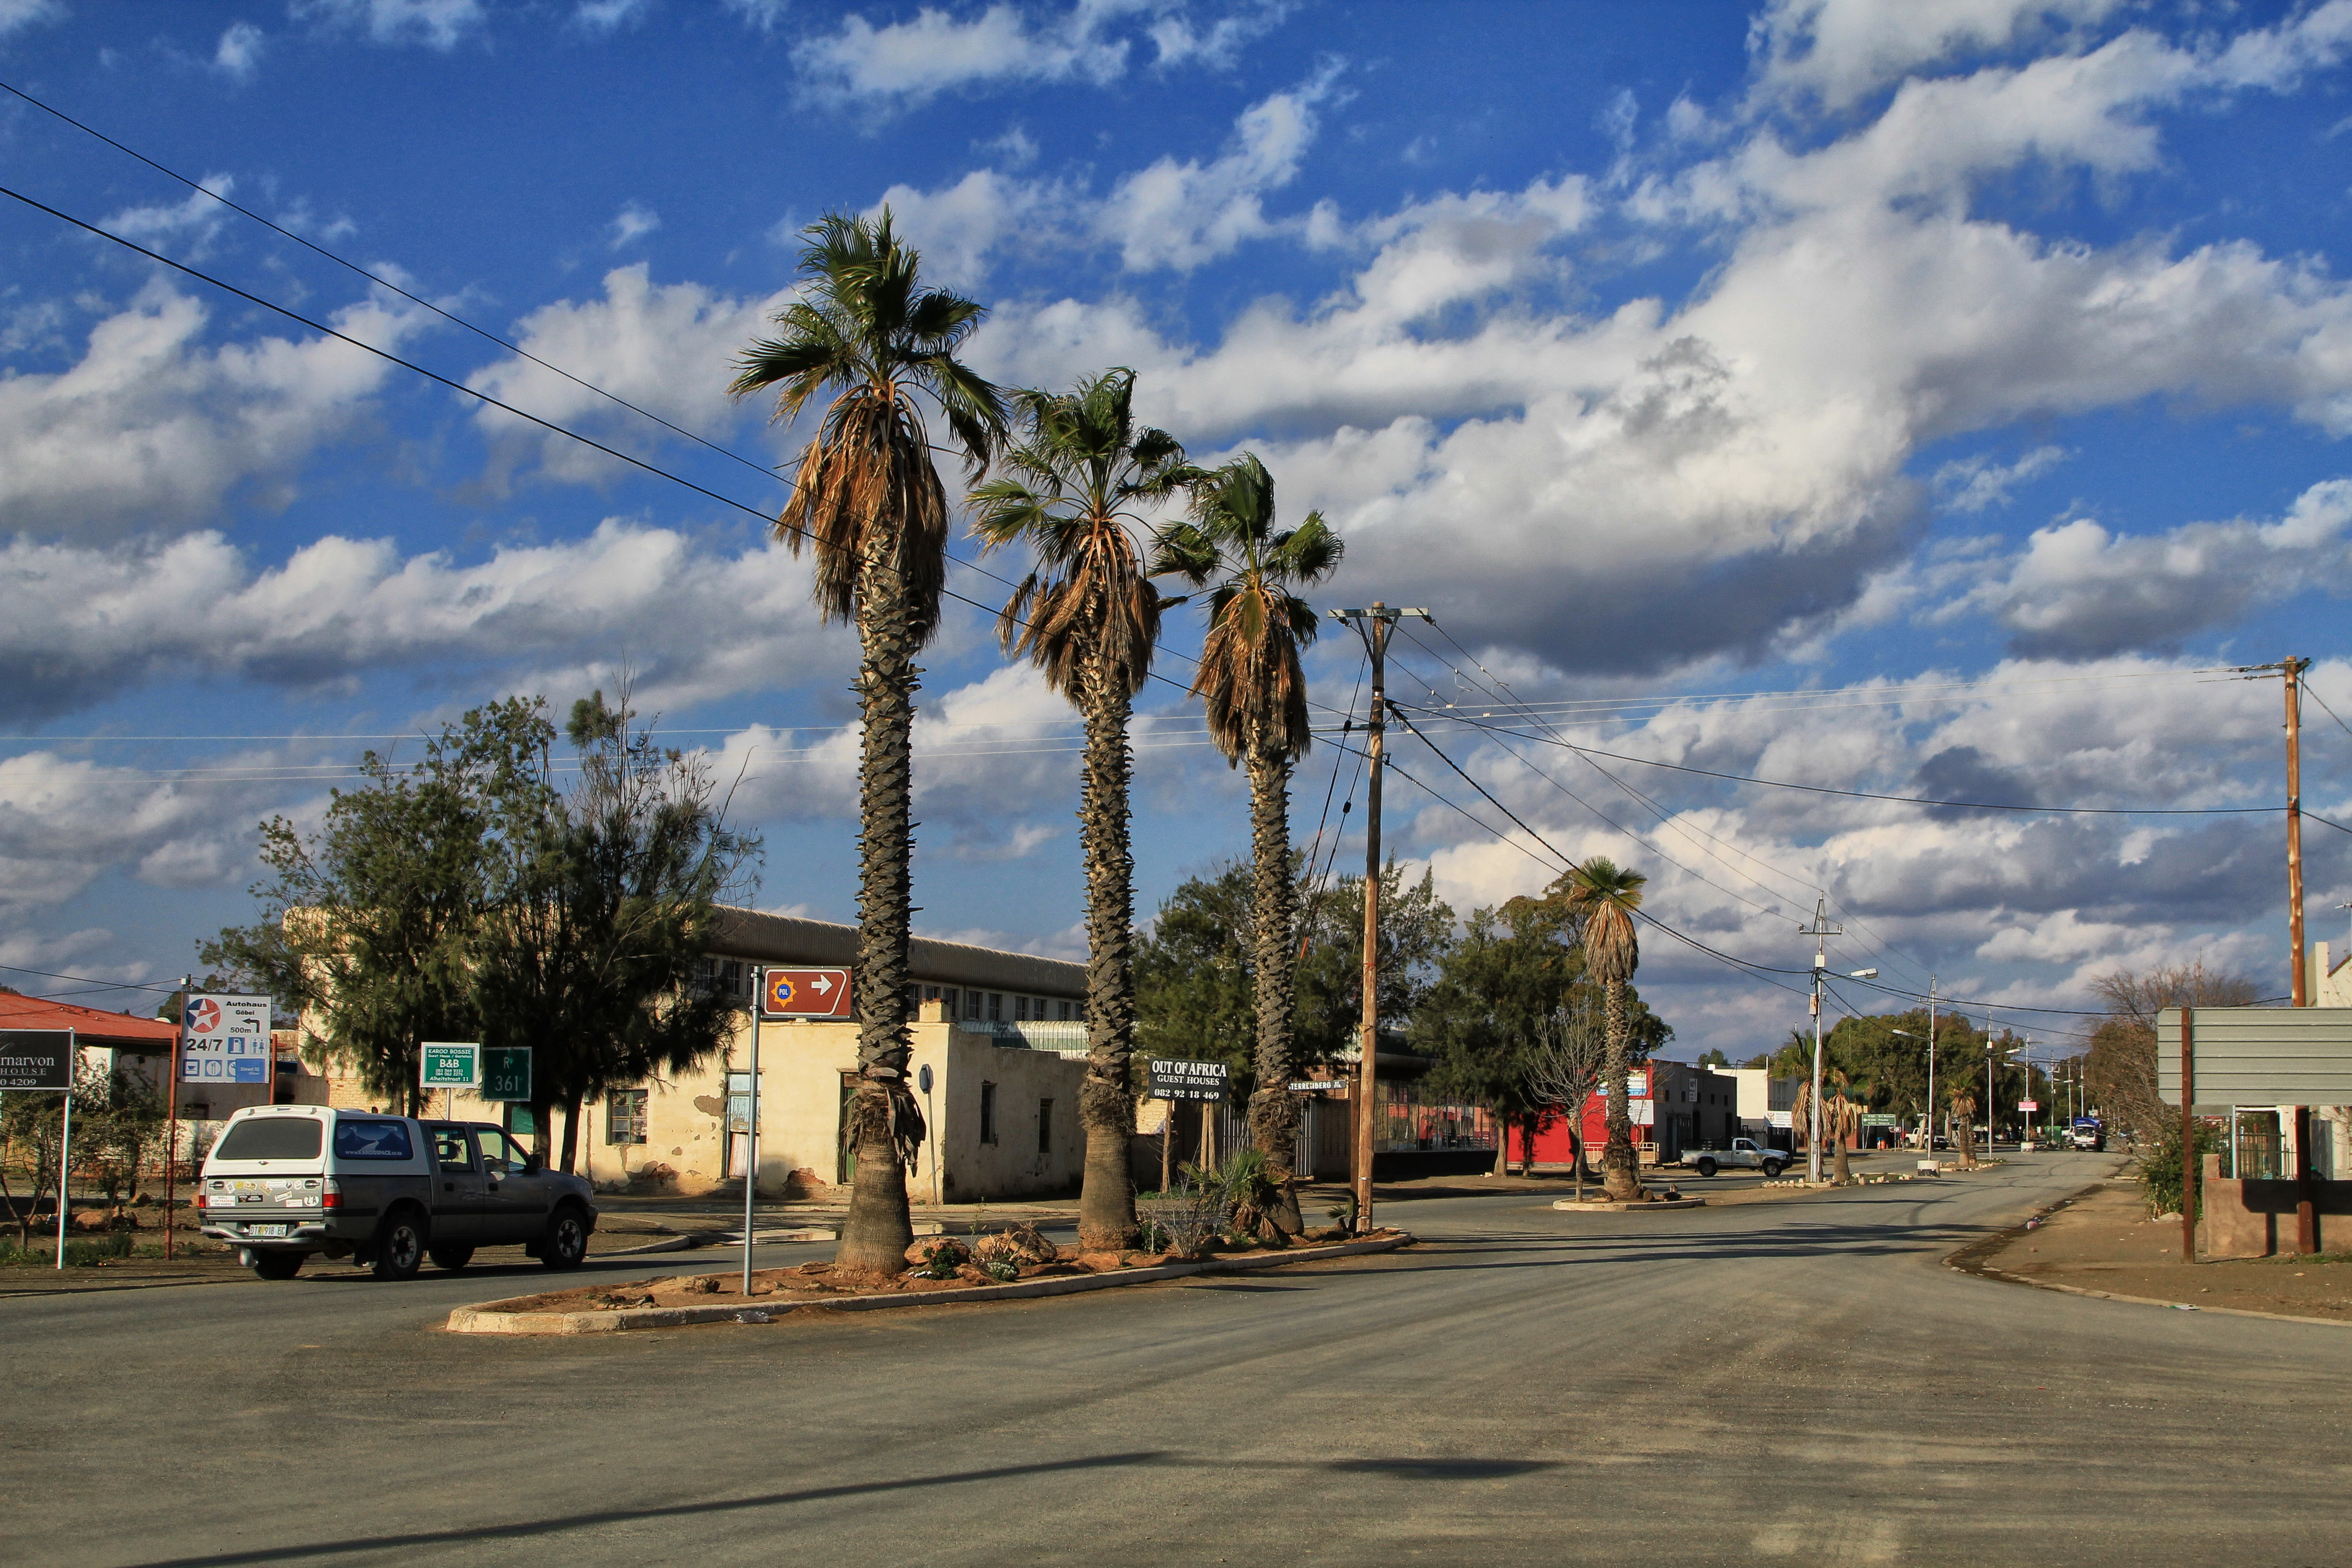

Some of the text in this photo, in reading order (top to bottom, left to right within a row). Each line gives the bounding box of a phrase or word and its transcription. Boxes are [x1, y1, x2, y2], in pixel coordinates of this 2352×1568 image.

[186, 1038, 223, 1052] 24/7
[440, 1059, 459, 1068] B&B
[504, 1057, 509, 1068] R
[1152, 1060, 1227, 1077] OUT OF AFRICA
[495, 1076, 518, 1091] 361
[1157, 1075, 1220, 1086] GUEST HOUSES
[1154, 1089, 1219, 1100] 082 92 18 469
[277, 1227, 286, 1235] EC
